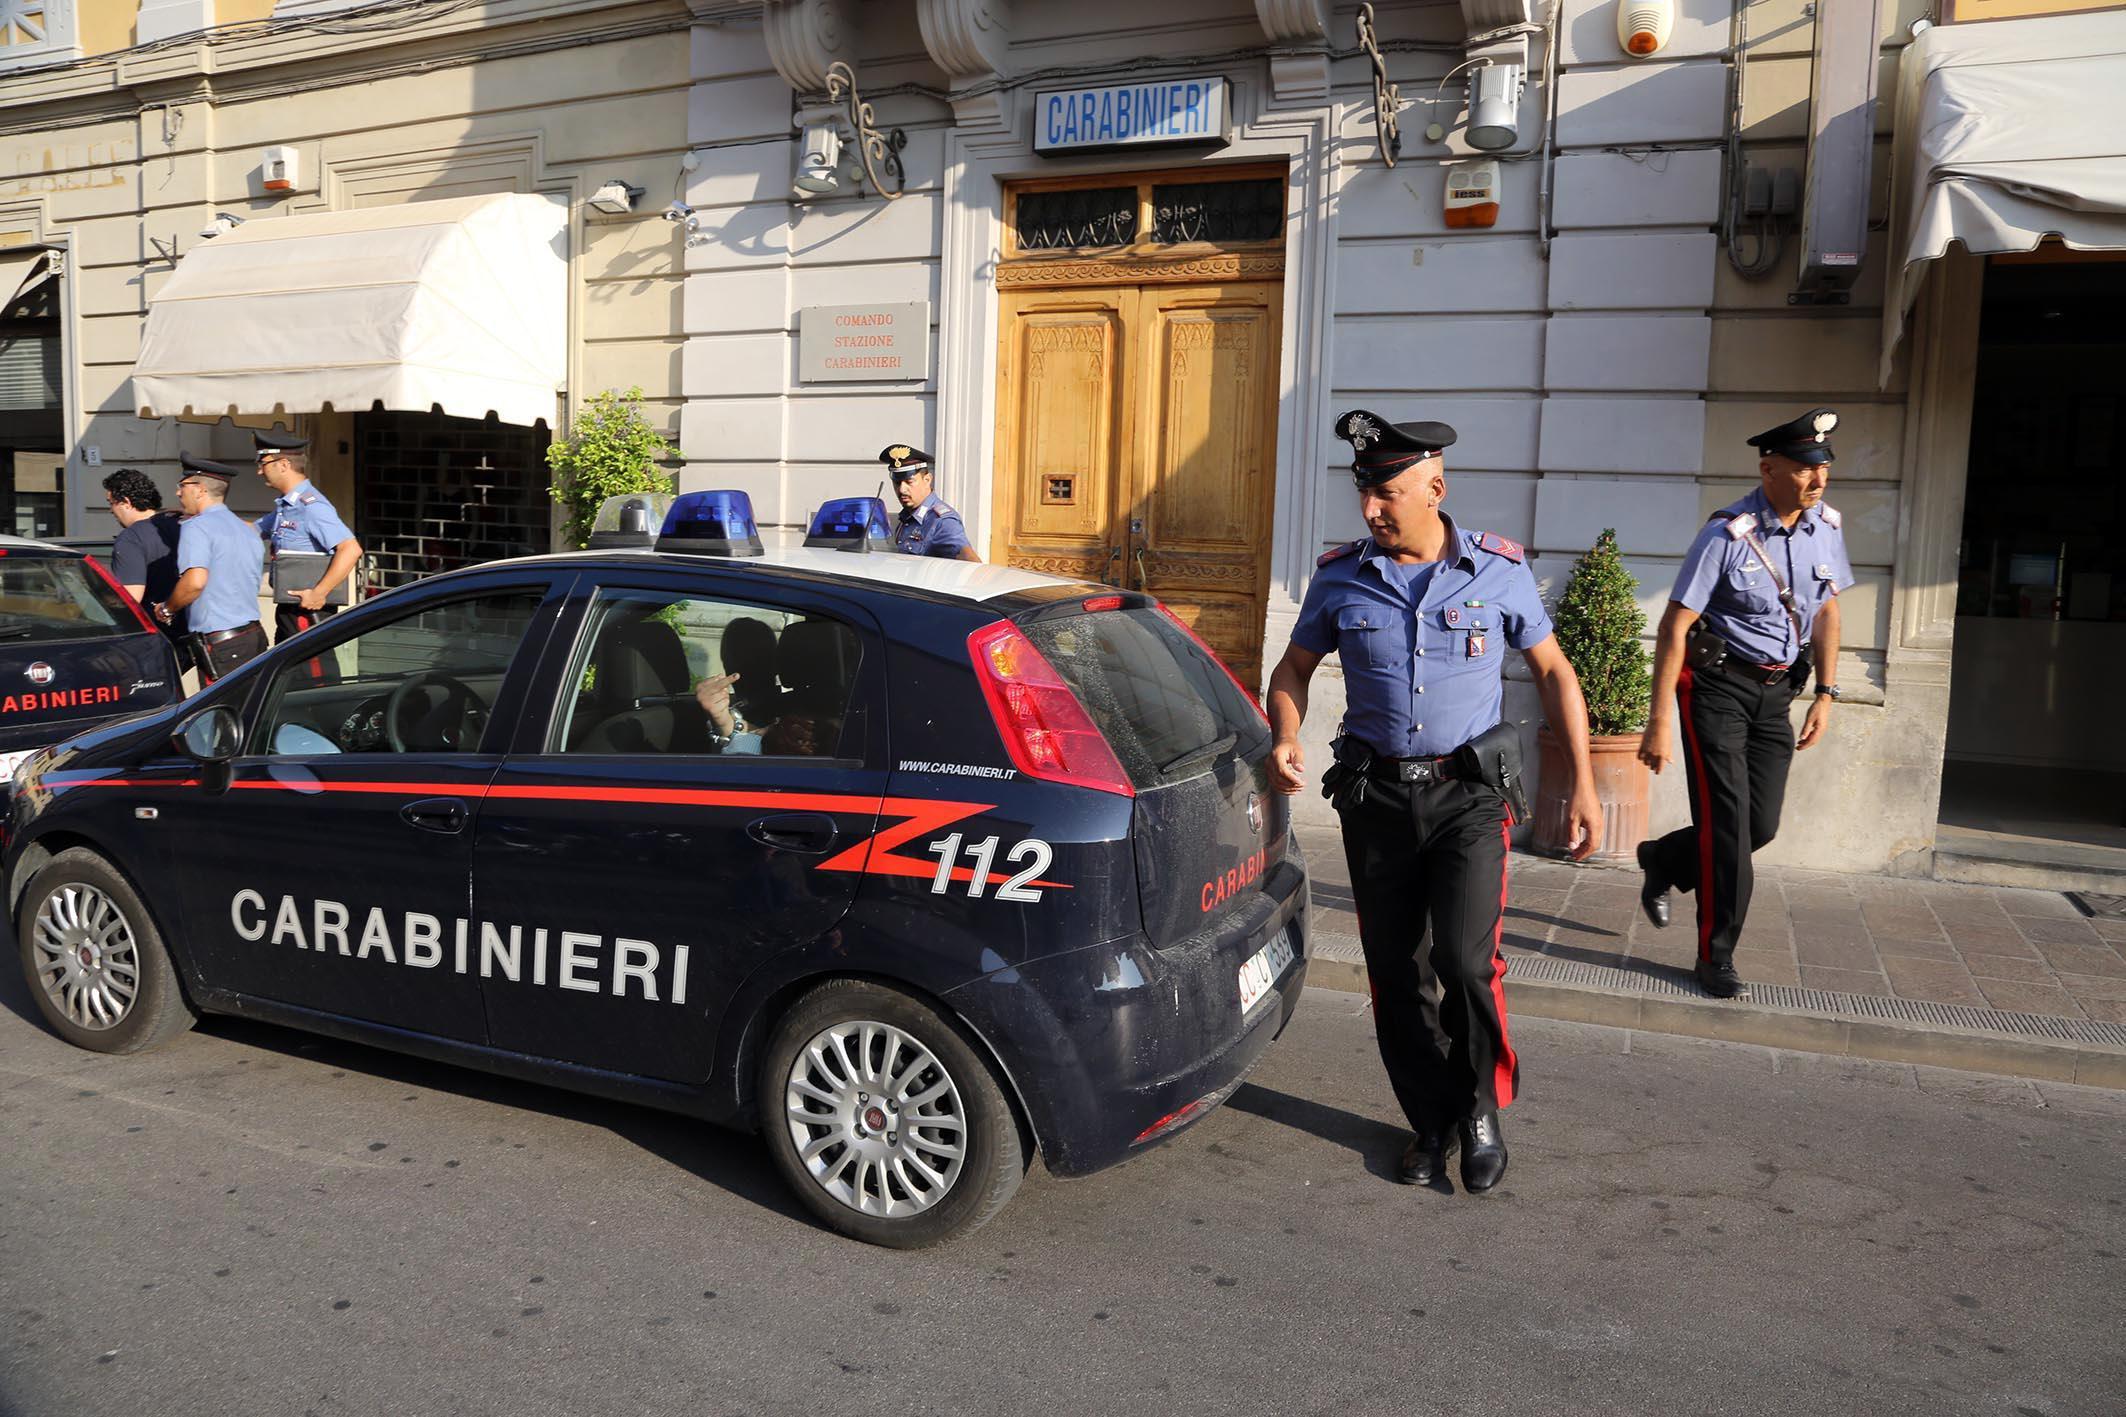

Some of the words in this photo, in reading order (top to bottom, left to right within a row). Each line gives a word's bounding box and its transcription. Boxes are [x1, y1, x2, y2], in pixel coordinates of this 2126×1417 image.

[1047, 82, 1211, 145] CARABINIERI
[835, 313, 894, 327] COMANDO
[834, 335, 894, 348] STAZIONE
[824, 356, 902, 369] CARABINIERI
[0, 685, 121, 713] ABINIERI
[899, 760, 1017, 780] WWW.CARABINIERI.IT
[928, 832, 1053, 903] 112
[230, 888, 690, 1005] CARABINIERI
